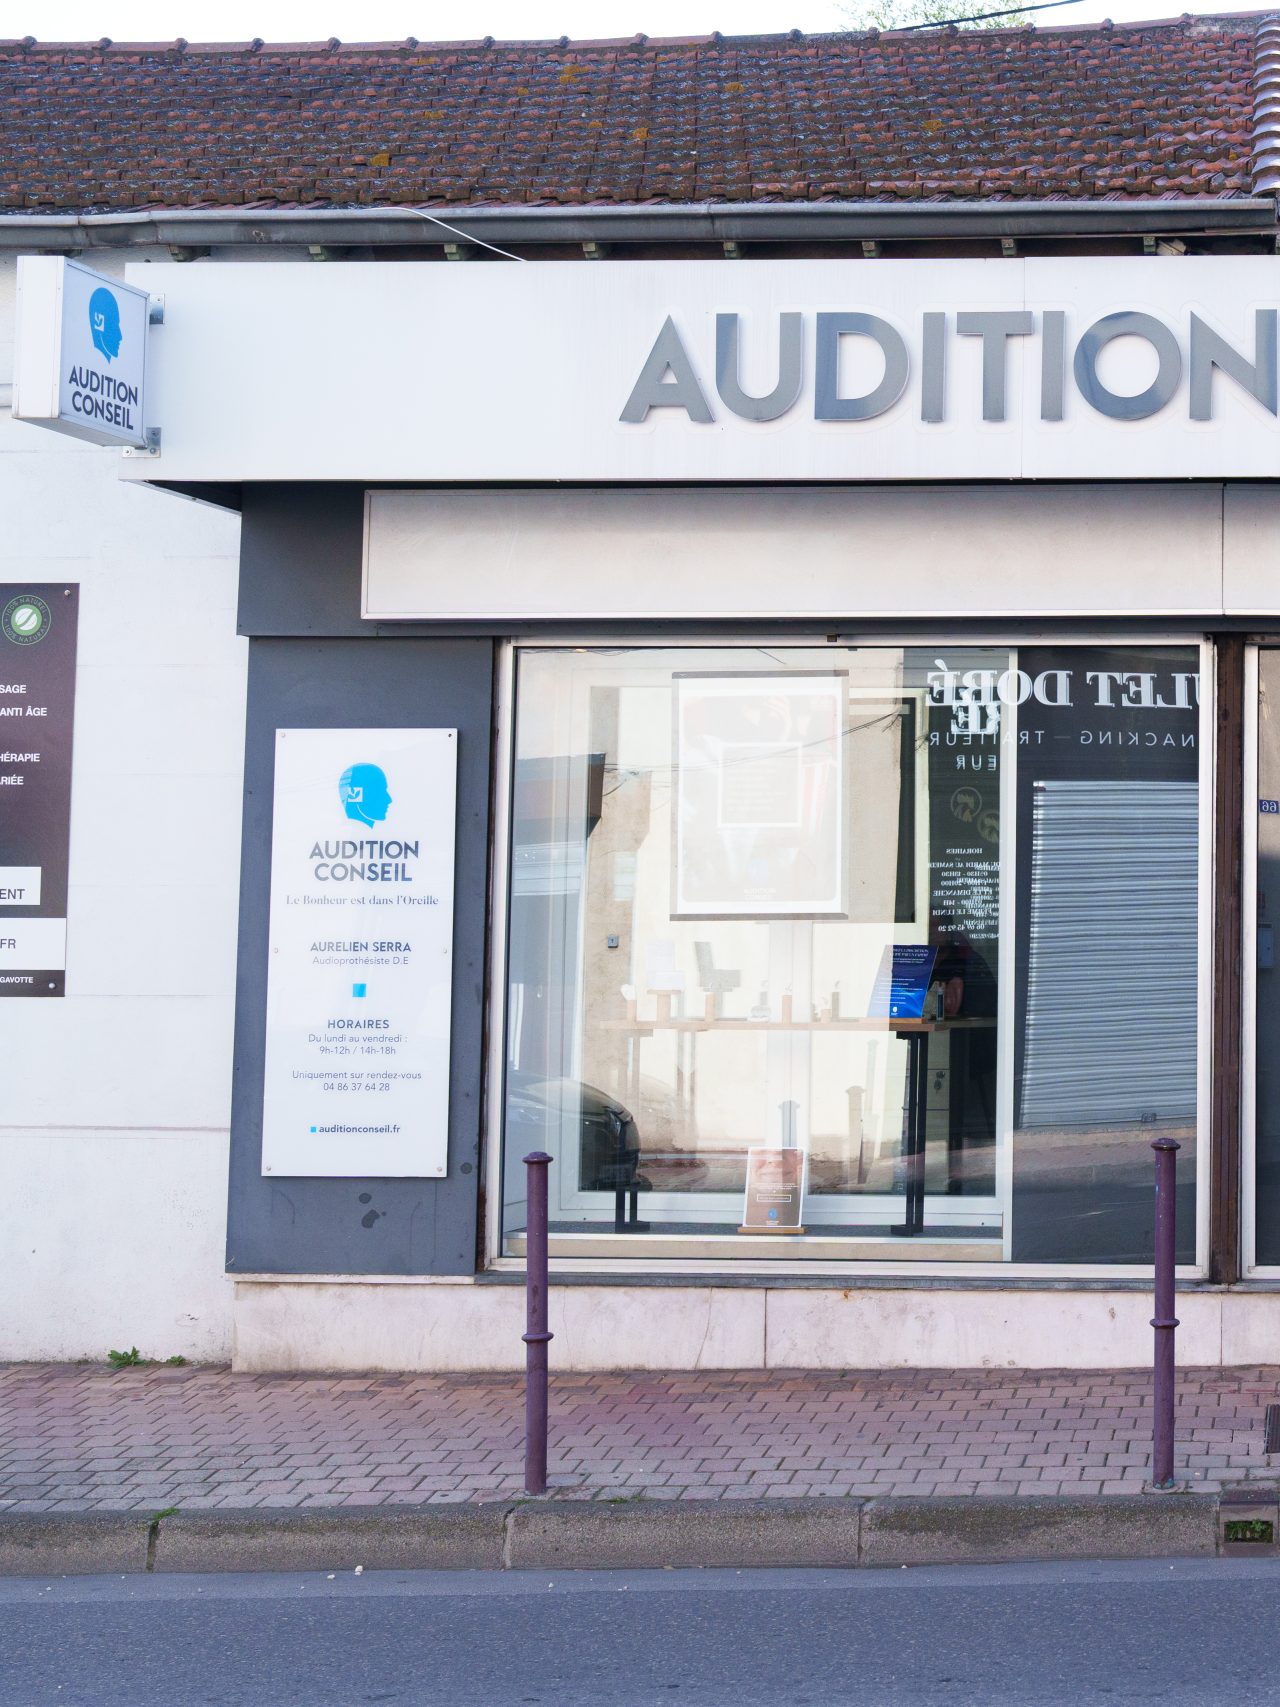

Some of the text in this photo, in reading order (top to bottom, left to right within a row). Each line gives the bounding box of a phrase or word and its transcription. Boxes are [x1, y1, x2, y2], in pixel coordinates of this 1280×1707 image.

[618, 309, 1278, 423] AUDITION
[68, 365, 138, 407] AUDITION
[72, 391, 134, 431] CONSEIL
[0, 684, 27, 694] SAGE
[0, 705, 48, 717] ANTI ÂGE
[0, 774, 24, 785] RIÉE
[309, 840, 419, 859] AUDITION
[314, 863, 413, 882] CONSEIL
[286, 895, 439, 905] Le Bonheur est dans l'Oreille
[310, 941, 412, 952] AURELIEN SERRA
[312, 956, 390, 967] Audioprothésiste
[0, 976, 34, 984] GAVOTTE
[327, 1019, 390, 1029] HORAIRES
[308, 1034, 321, 1043] Du
[324, 1034, 347, 1043] lundi
[362, 1034, 402, 1043] vendredi
[319, 1046, 350, 1055] 9h-12h
[361, 1046, 396, 1055] 14h-18h
[292, 1070, 347, 1082] Uniquement
[366, 1070, 422, 1080] rendez-vous
[323, 1083, 390, 1091] 04 86 37 64 28
[319, 1124, 401, 1134] auditionconseil.fr
